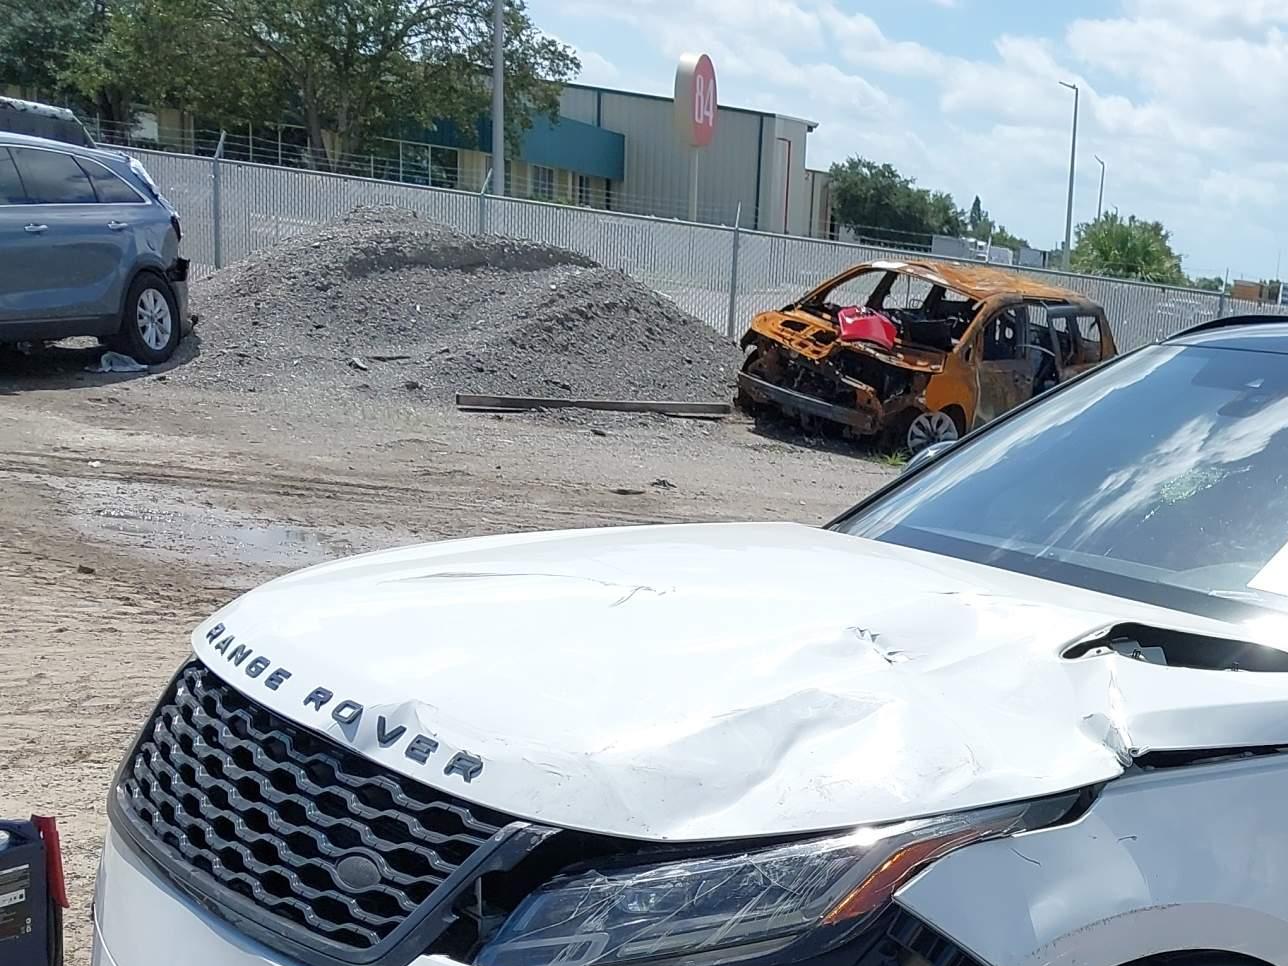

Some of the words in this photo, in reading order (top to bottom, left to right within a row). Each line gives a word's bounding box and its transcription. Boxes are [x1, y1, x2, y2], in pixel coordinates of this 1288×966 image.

[695, 74, 714, 127] 84
[205, 622, 293, 692] RANGE
[302, 686, 485, 784] ROVER
